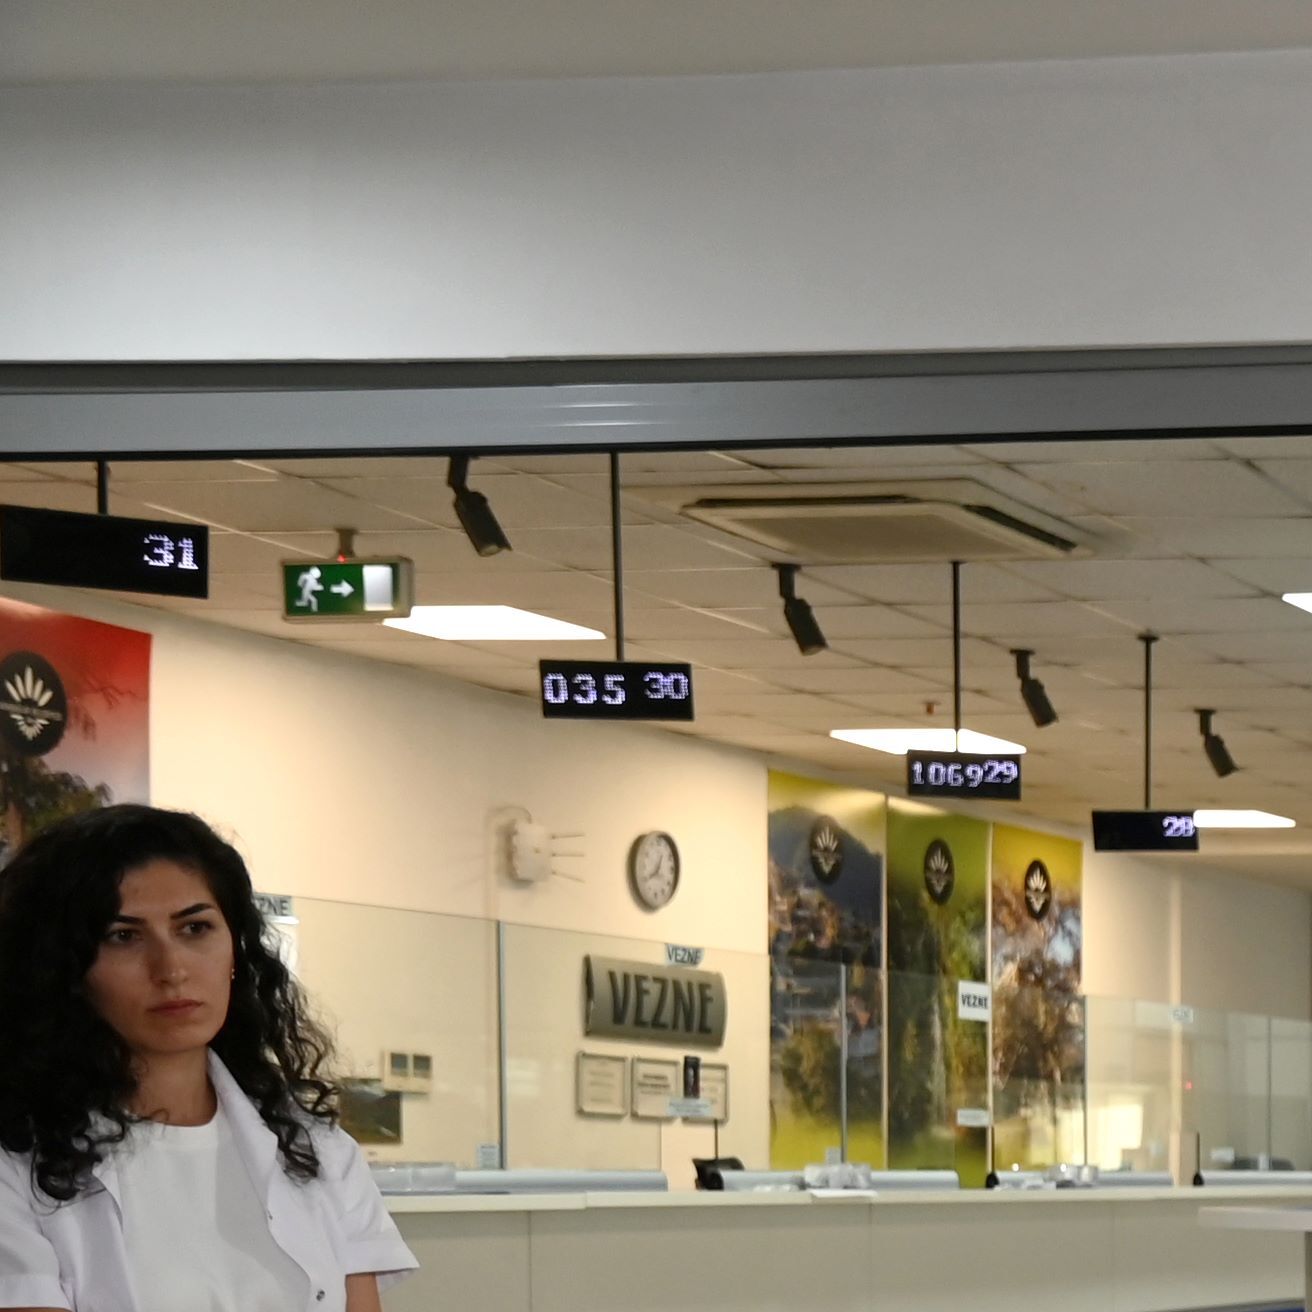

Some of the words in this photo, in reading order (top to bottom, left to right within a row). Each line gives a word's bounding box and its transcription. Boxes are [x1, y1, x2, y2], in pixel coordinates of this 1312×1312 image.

[143, 533, 199, 570] 31
[543, 673, 626, 705] 035
[643, 671, 689, 699] 30
[912, 761, 983, 788] 1069
[983, 759, 1018, 784] 29
[667, 944, 703, 966] VEZNE
[607, 969, 714, 1035] VEZNE
